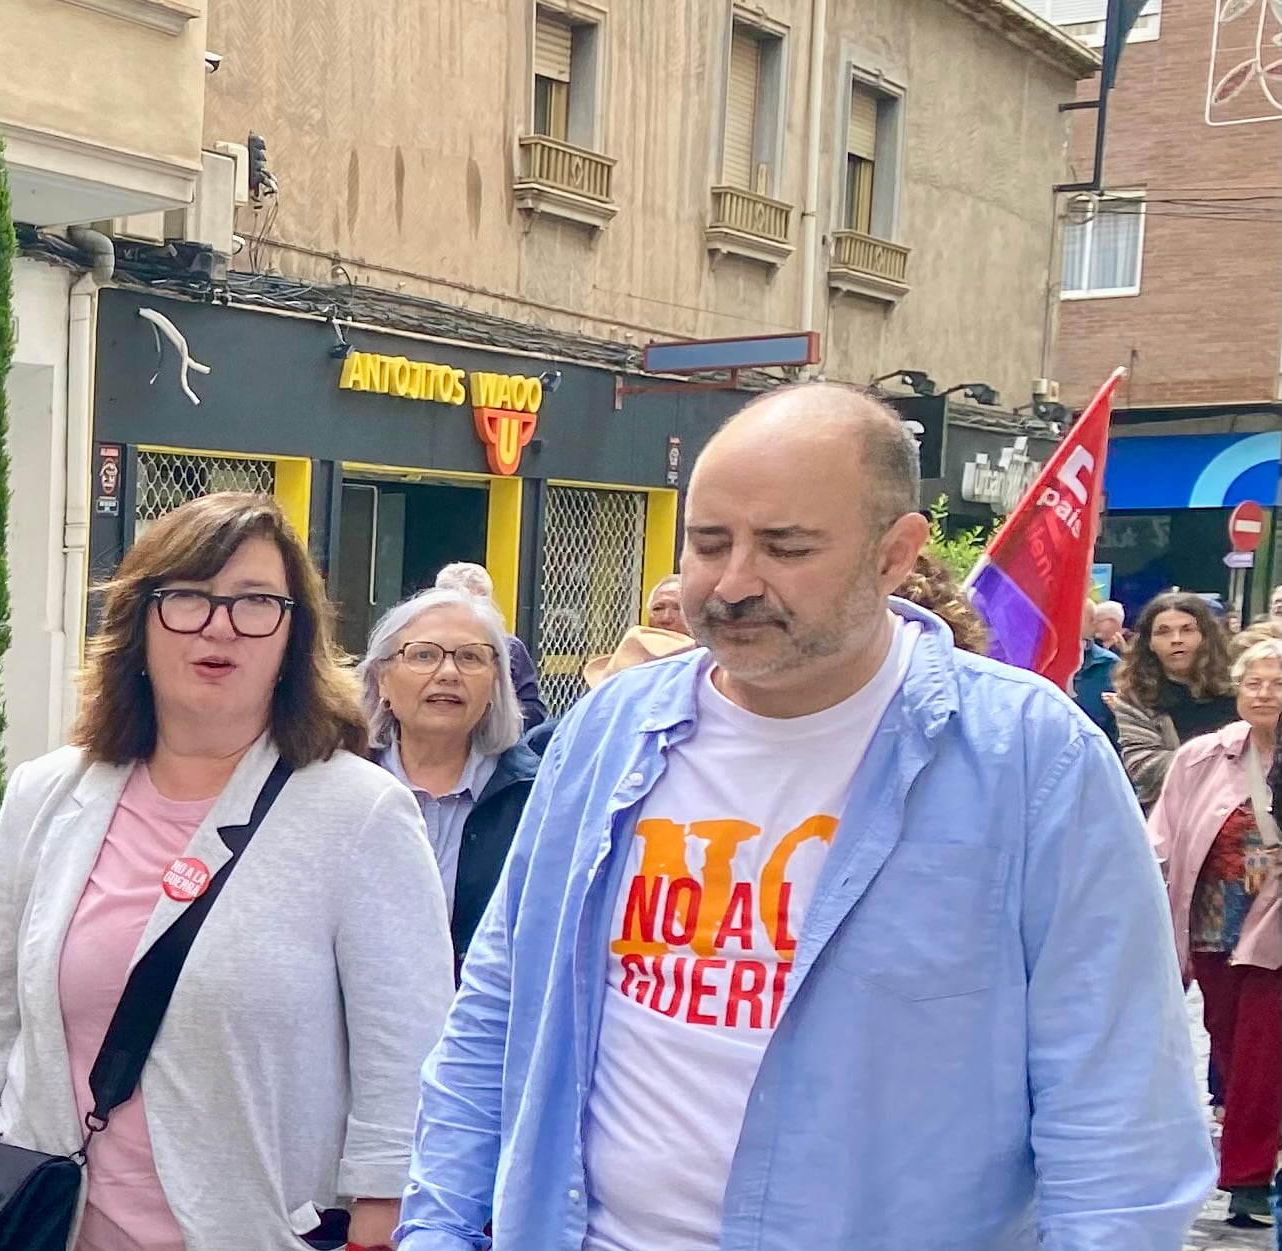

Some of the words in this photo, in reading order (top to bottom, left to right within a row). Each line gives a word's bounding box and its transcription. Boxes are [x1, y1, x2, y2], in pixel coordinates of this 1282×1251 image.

[340, 351, 466, 405] ANTOJITOS
[622, 875, 702, 947] NO
[714, 882, 752, 950] A
[774, 882, 797, 951] L
